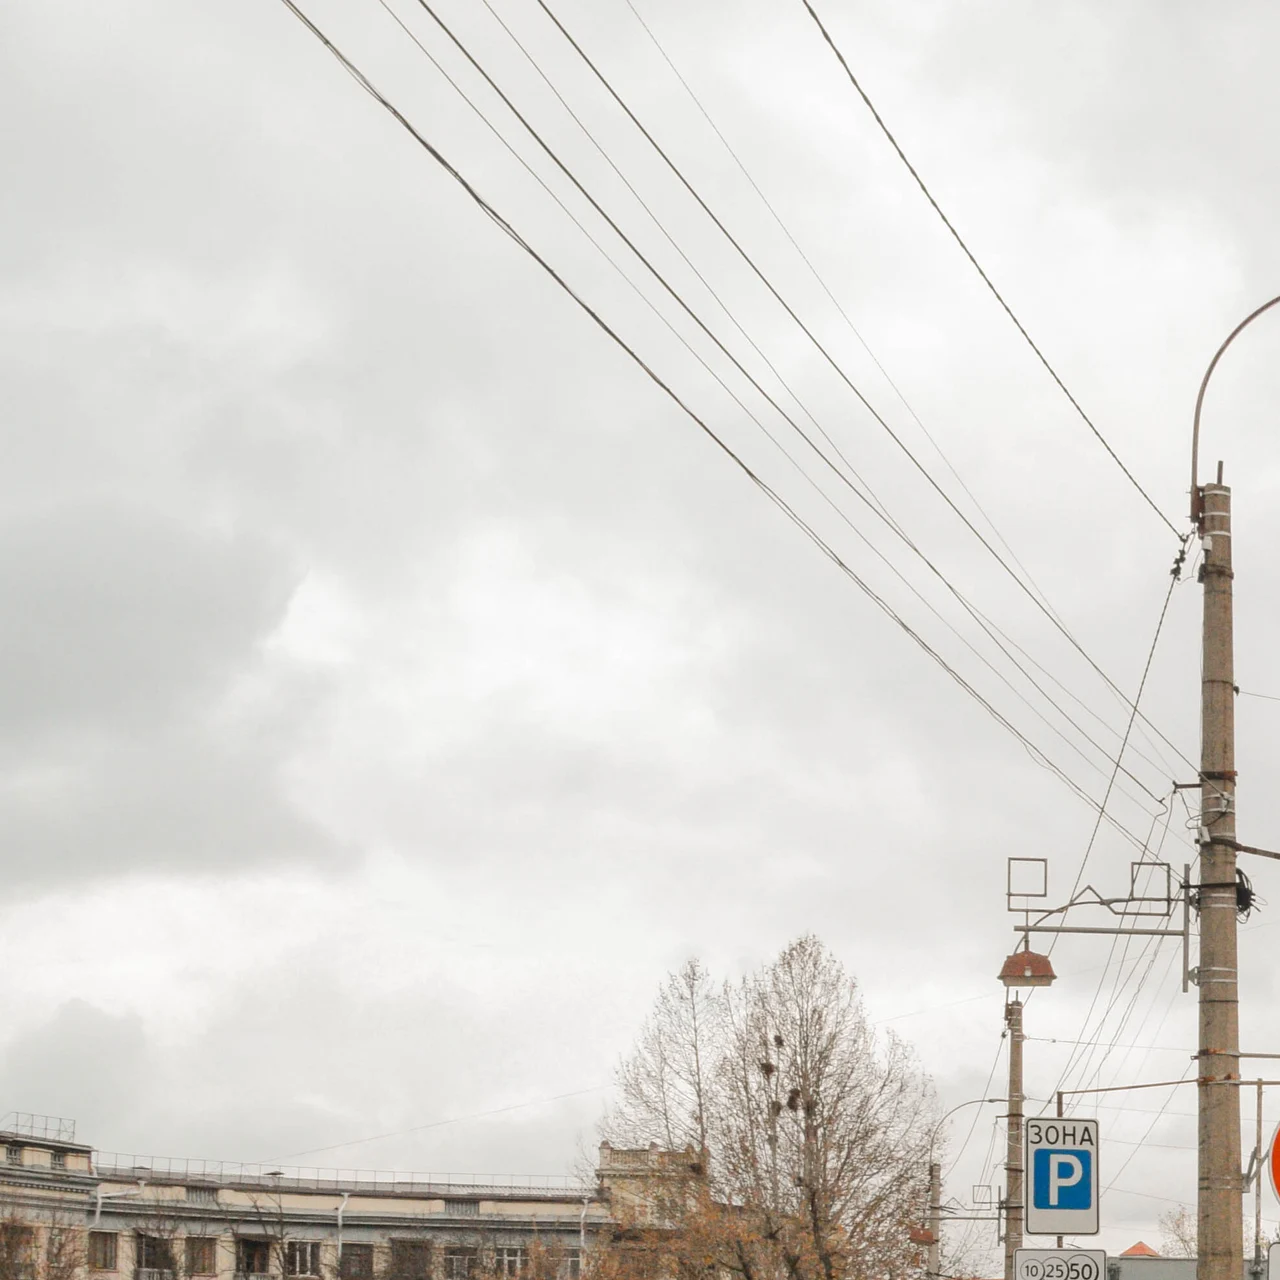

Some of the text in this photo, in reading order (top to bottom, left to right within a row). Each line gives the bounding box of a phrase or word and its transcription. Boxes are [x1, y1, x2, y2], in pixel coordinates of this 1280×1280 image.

[1029, 1124, 1095, 1146] ЗОНА
[1049, 1153, 1083, 1206] P
[1024, 1262, 1093, 1280] 10 25 50
